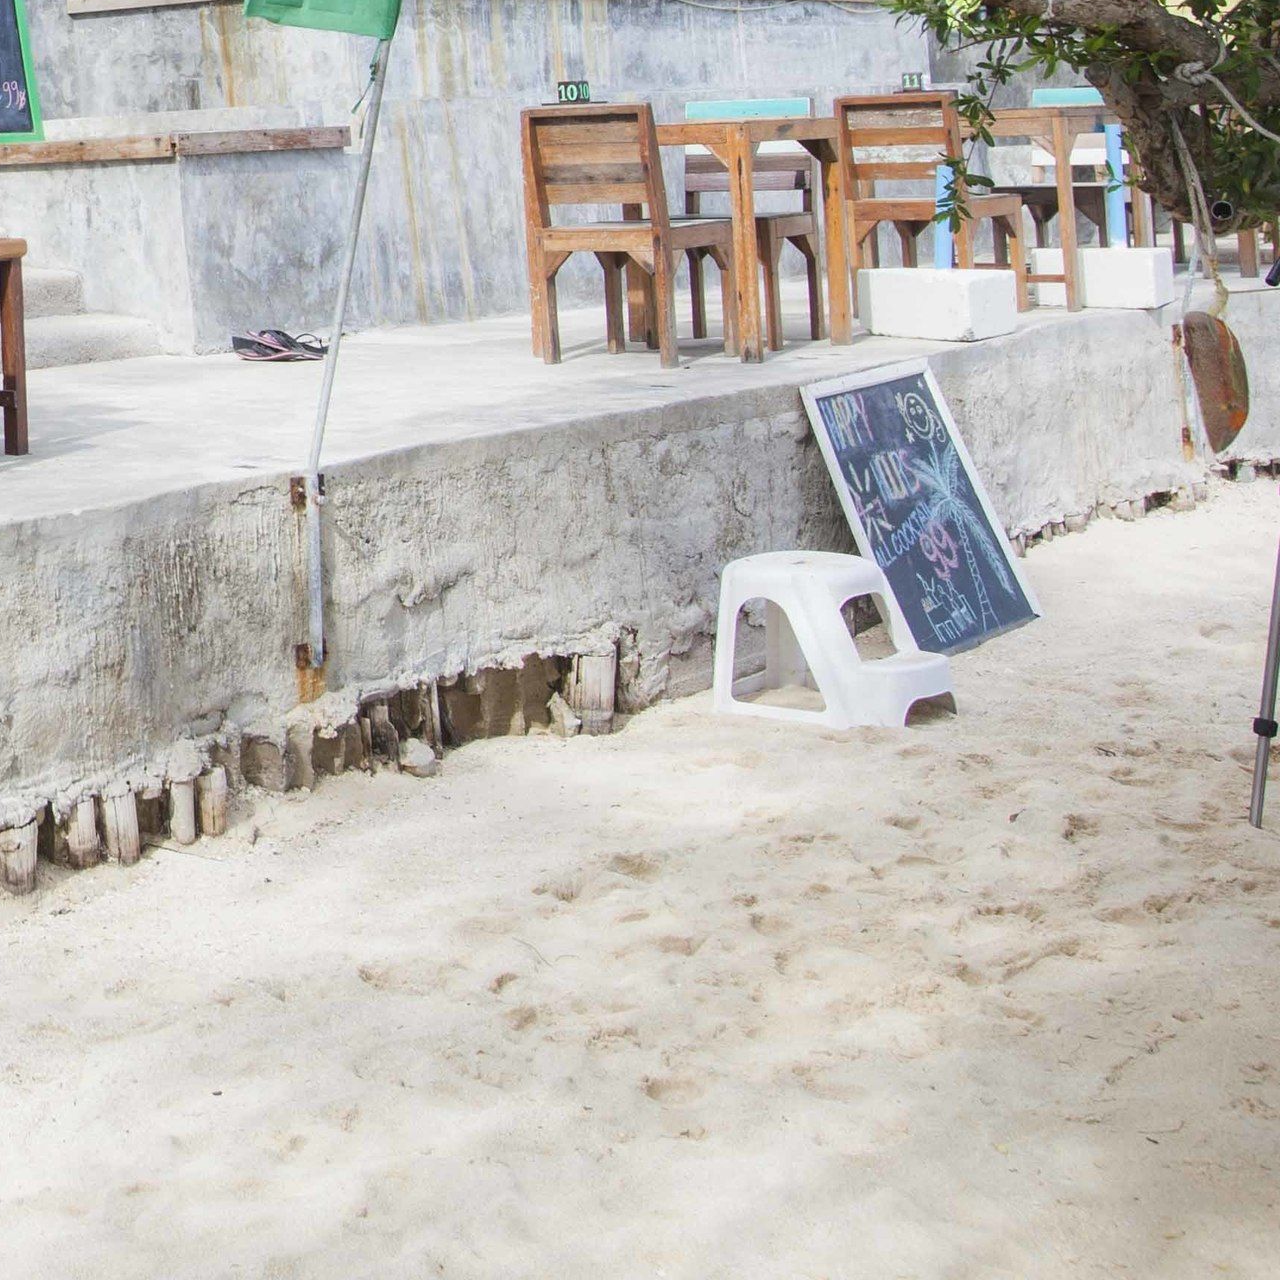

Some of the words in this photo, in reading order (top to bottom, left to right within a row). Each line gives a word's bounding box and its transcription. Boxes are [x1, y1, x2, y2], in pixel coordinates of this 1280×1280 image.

[903, 74, 920, 88] 11
[558, 84, 578, 101] 10
[820, 393, 874, 451] HAPPY
